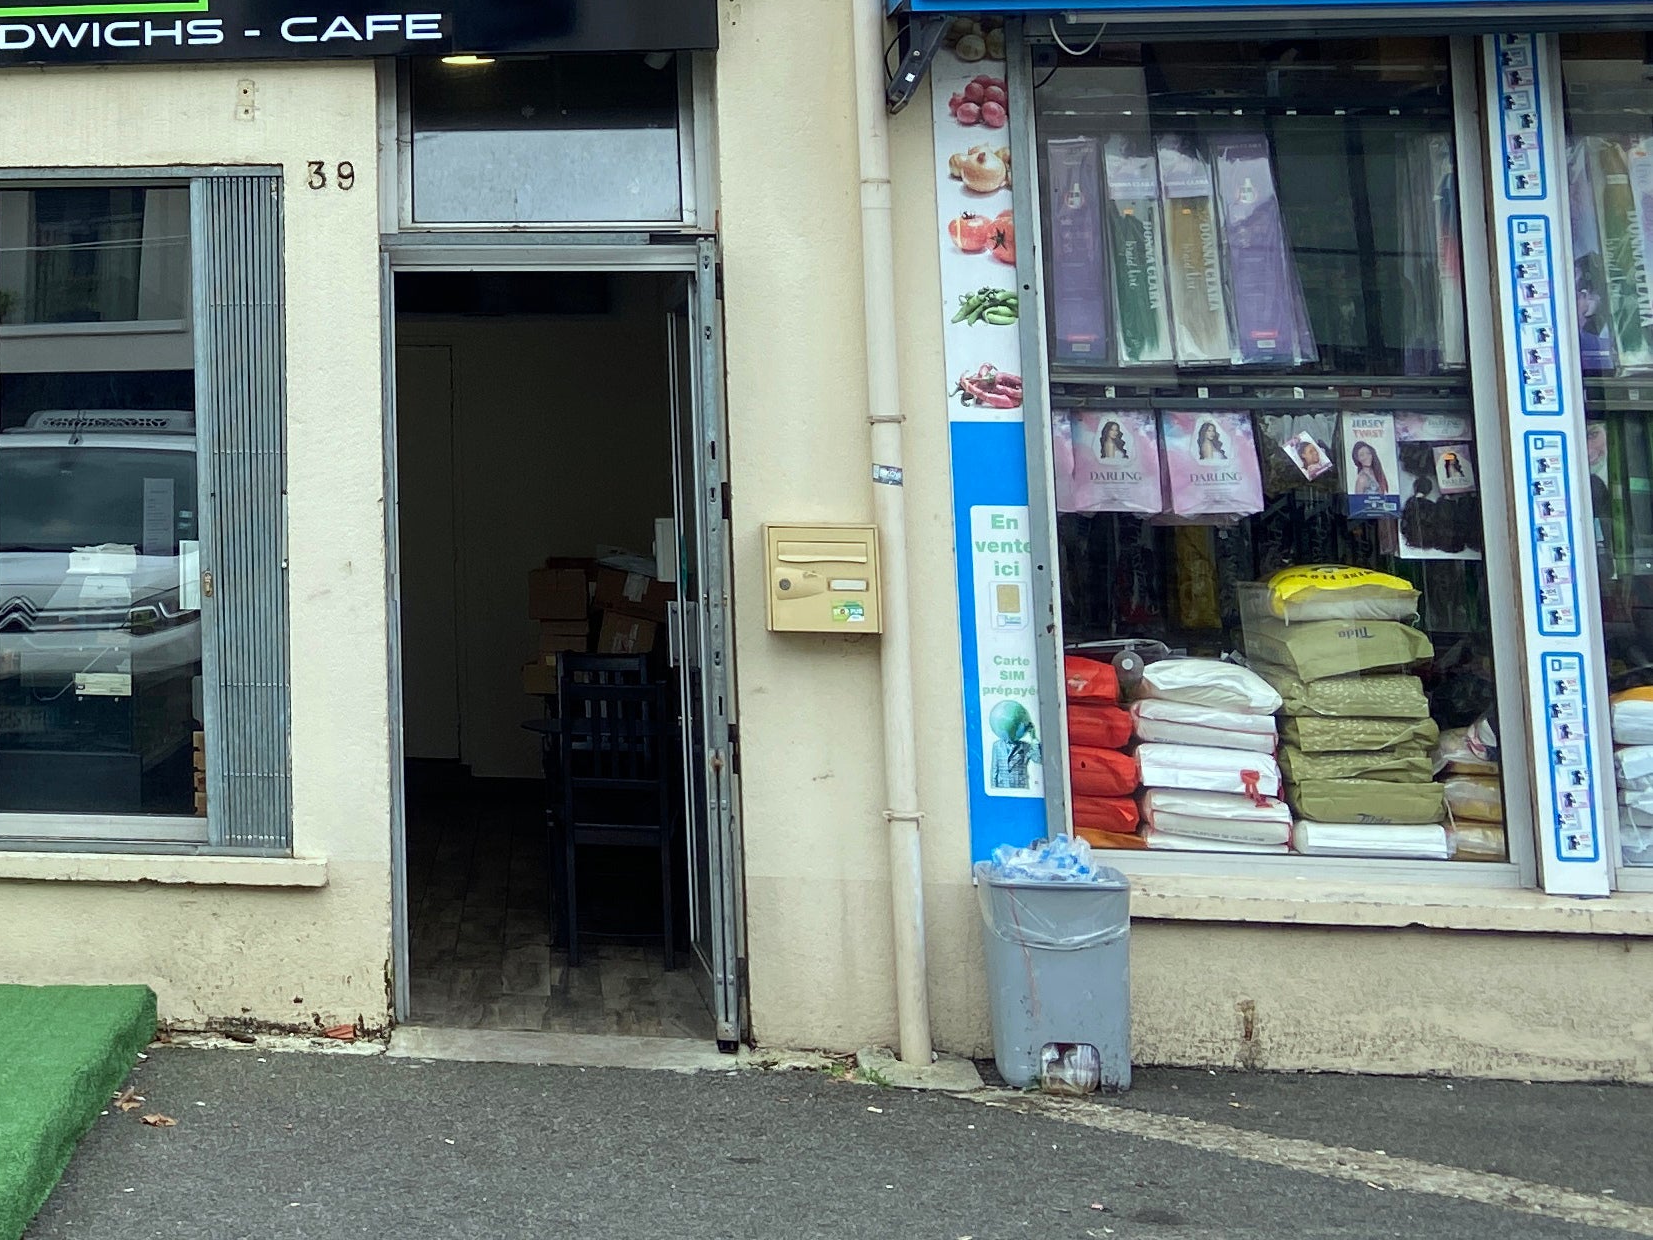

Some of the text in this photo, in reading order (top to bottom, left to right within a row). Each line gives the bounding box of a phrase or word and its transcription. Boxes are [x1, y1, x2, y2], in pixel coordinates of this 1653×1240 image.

[280, 13, 443, 42] CAFE
[307, 160, 355, 191] 39
[1352, 419, 1385, 428] JERSEY
[1352, 429, 1385, 438] TWIST
[1089, 471, 1143, 482] DARLING
[1190, 471, 1243, 483] DARLING
[991, 514, 1018, 530] En
[994, 560, 1020, 576] ici
[1338, 626, 1376, 639] Tilda
[993, 655, 1030, 666] Carte
[999, 671, 1025, 681] SIM
[982, 684, 1038, 698] prépayé
